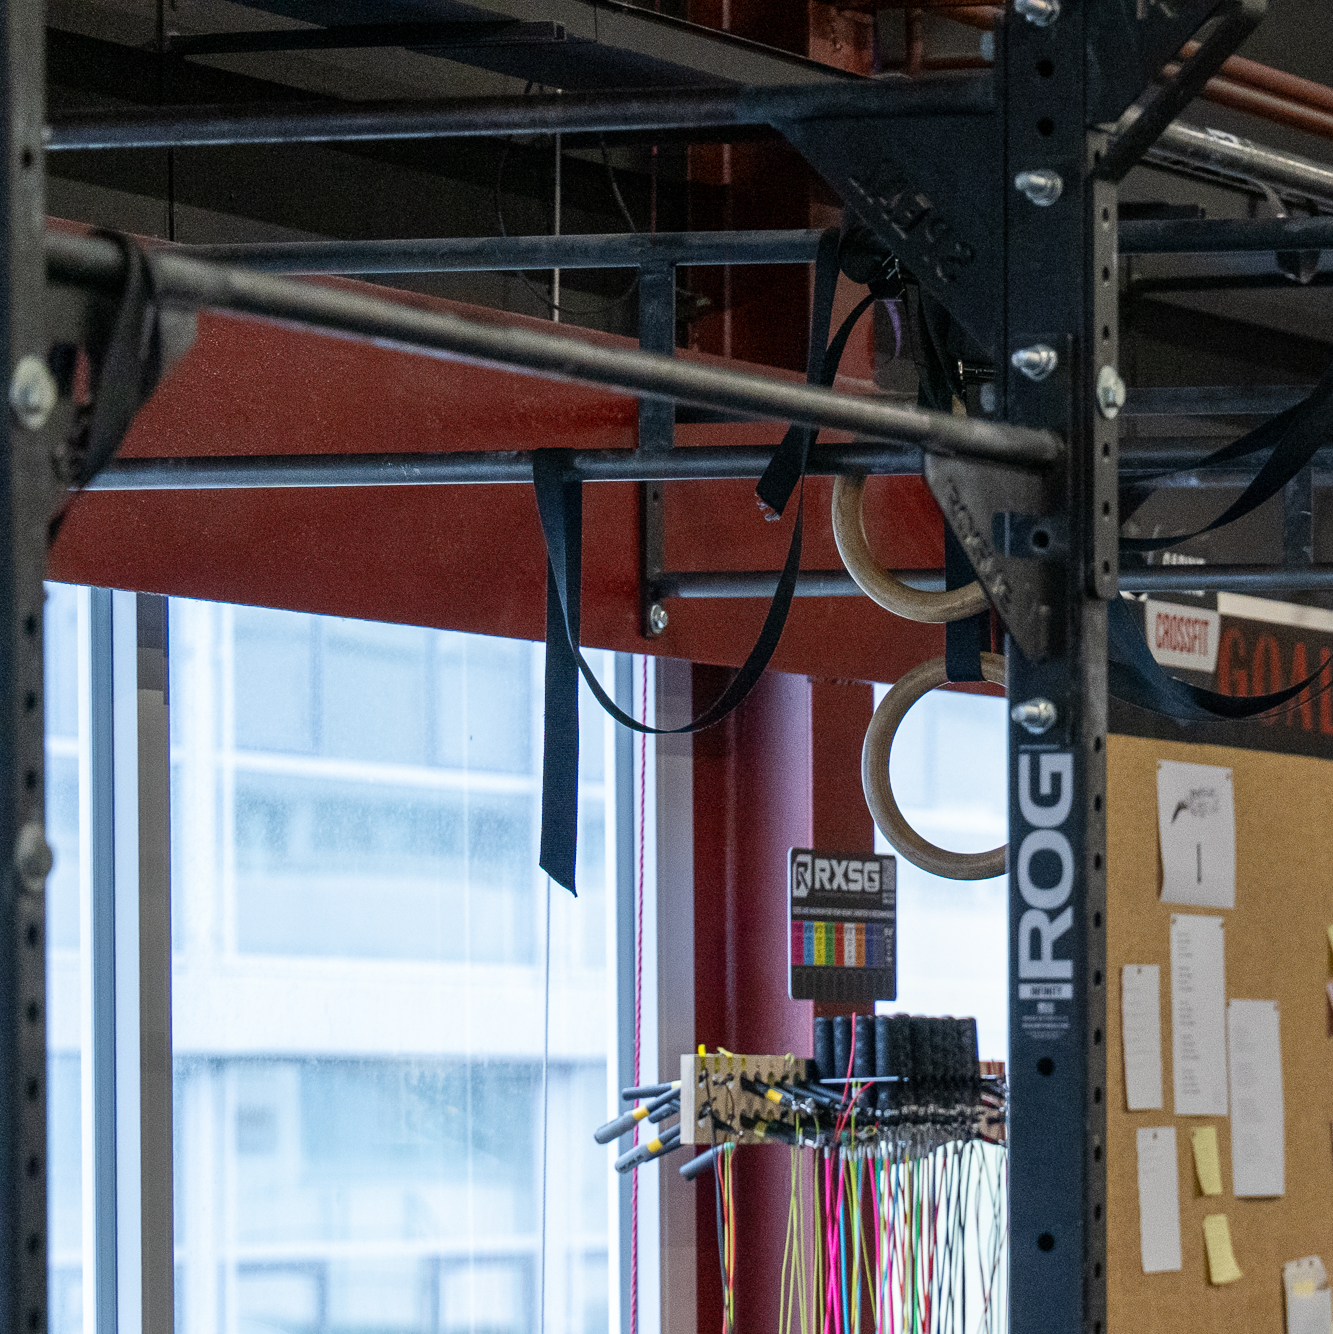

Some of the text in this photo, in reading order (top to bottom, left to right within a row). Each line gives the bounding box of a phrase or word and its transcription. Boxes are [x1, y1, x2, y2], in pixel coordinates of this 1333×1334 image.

[1156, 612, 1209, 656] CROSSFIT
[814, 858, 881, 892] RXSG
[1017, 745, 1074, 979] ROG
